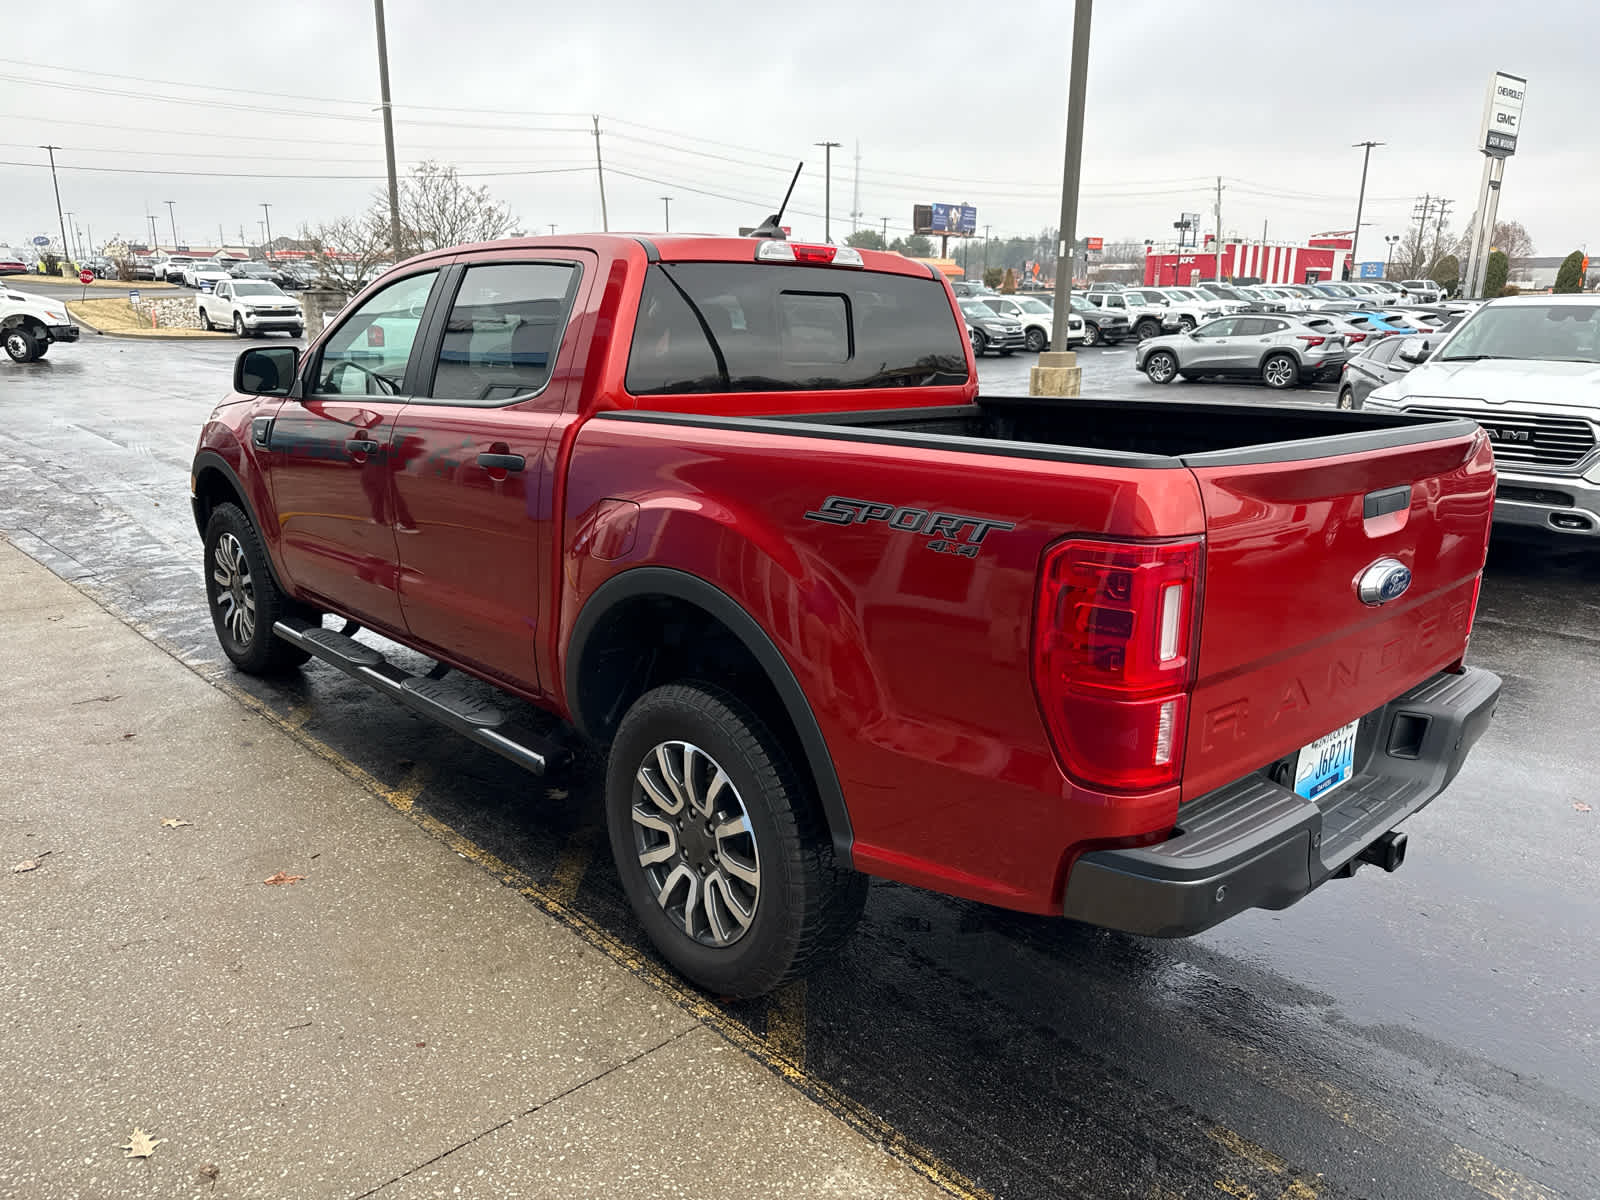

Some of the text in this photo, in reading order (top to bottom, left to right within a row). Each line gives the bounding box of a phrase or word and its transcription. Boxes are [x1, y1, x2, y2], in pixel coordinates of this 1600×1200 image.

[1497, 86, 1523, 100] CHEVROLET
[1496, 112, 1516, 126] GMC
[1178, 256, 1196, 264] KFC
[1485, 428, 1529, 441] AM
[804, 496, 1016, 543] SPORT
[1202, 600, 1465, 752] RANGER
[1315, 733, 1354, 779] J6P211
